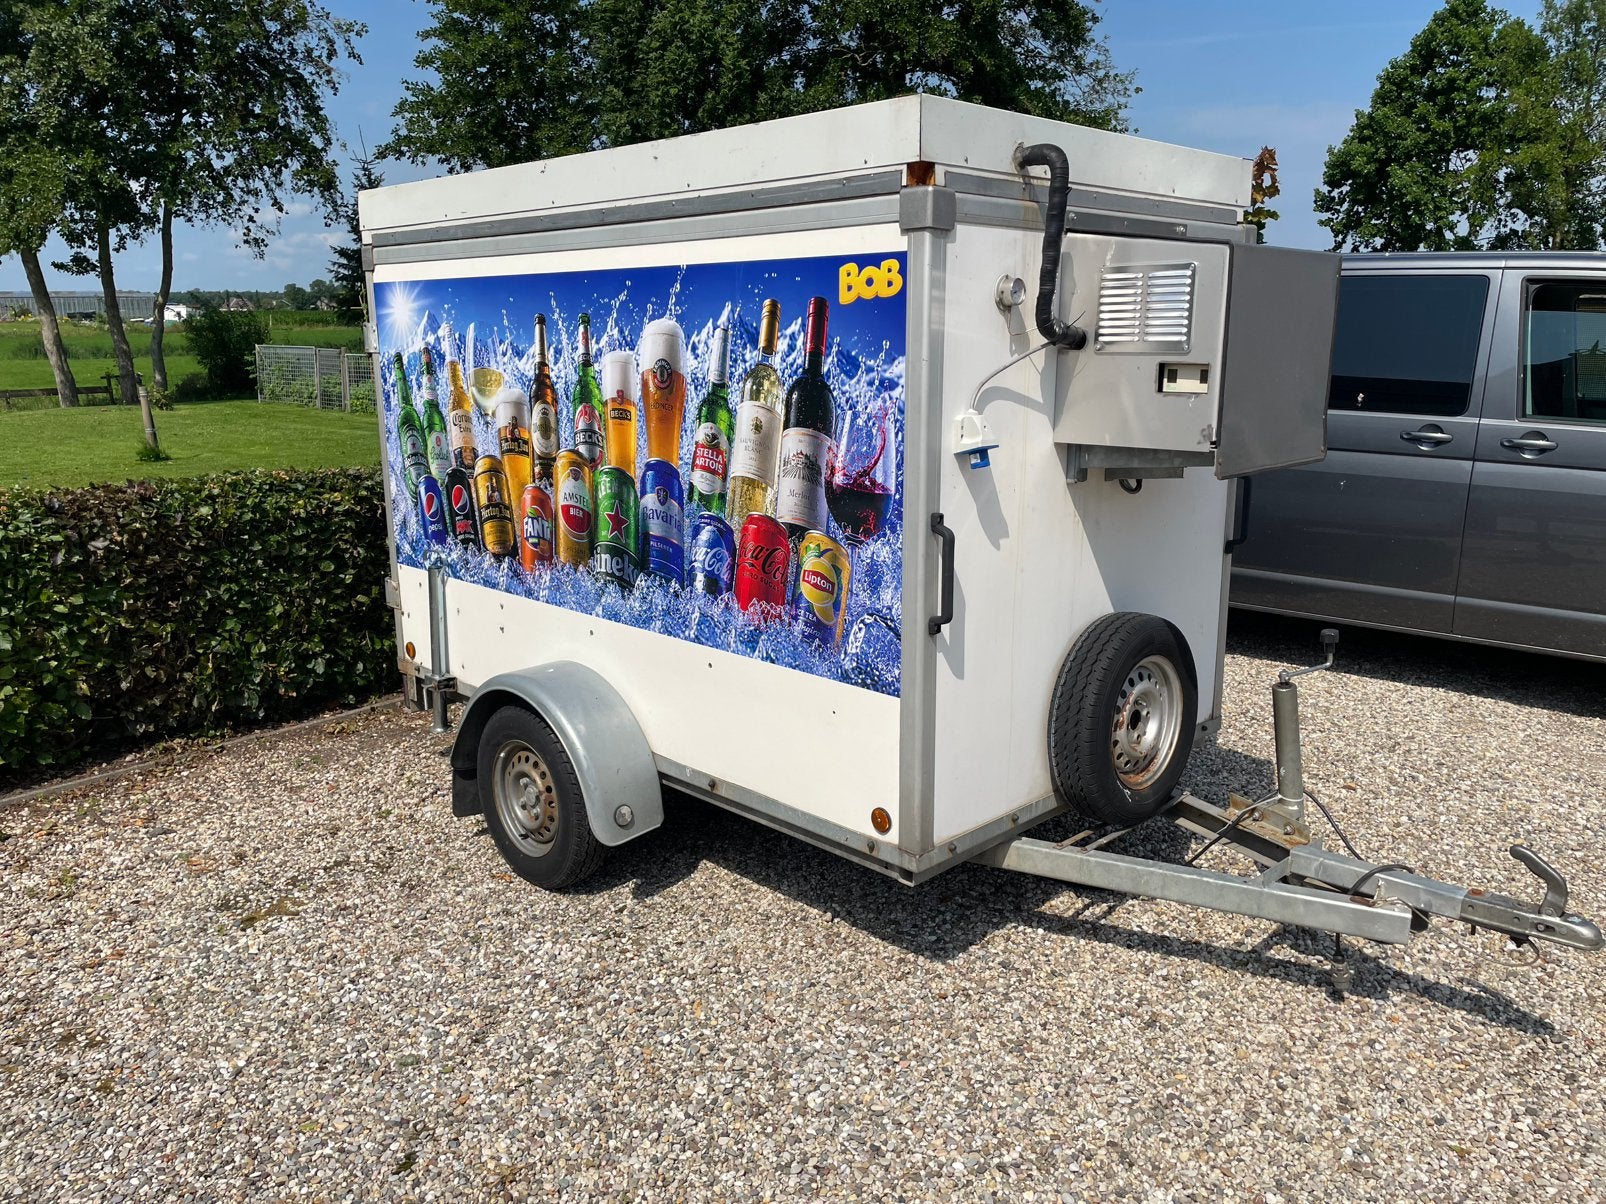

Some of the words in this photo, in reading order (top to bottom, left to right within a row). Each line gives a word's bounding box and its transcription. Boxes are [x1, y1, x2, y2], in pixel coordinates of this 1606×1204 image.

[839, 259, 903, 305] BOB
[610, 410, 631, 420] BECK'S
[575, 432, 604, 447] BECK'S
[696, 447, 723, 464] STELLA
[695, 457, 723, 473] ARTOIS
[569, 507, 584, 518] BIER
[642, 506, 684, 534] Bavaria
[804, 570, 832, 592] Lipton
